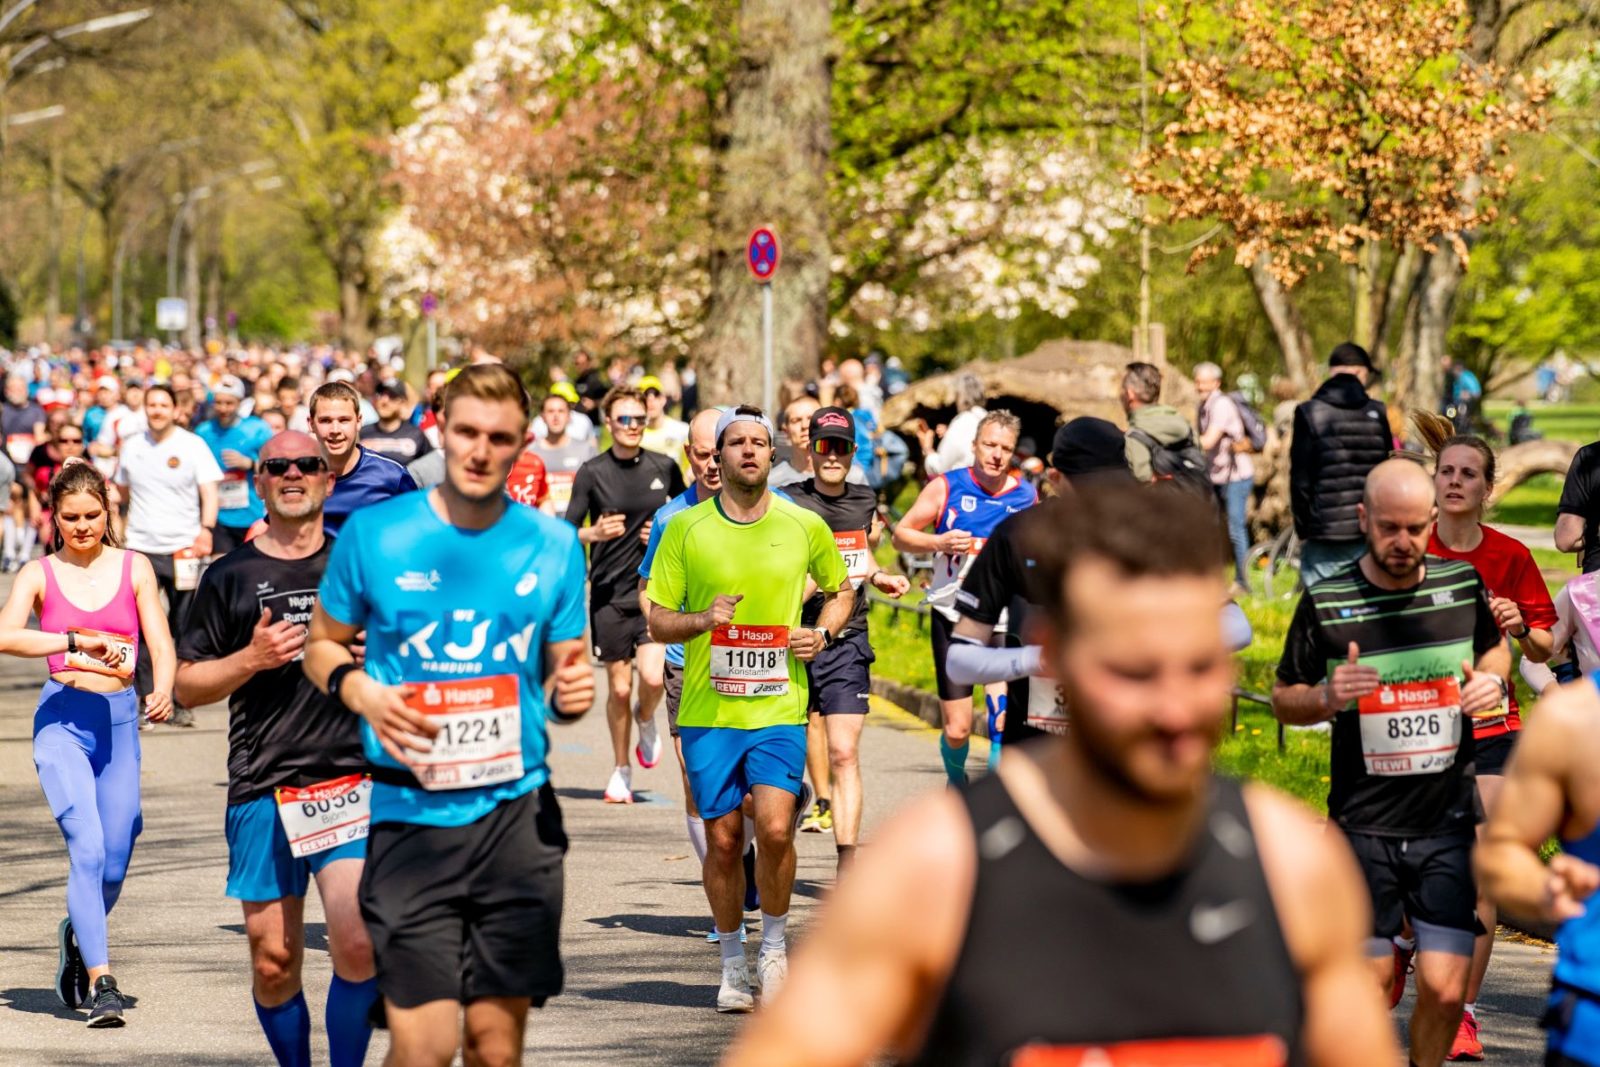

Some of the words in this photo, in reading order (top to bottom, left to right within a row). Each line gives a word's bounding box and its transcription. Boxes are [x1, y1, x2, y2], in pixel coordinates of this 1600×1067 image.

[844, 553, 858, 568] 57
[742, 630, 773, 642] Haspa
[726, 650, 776, 668] 11018
[421, 660, 483, 674] HAMBURG
[728, 667, 770, 676] Konstantin
[443, 687, 494, 703] Haspa
[716, 683, 745, 693] REWE
[763, 683, 783, 692] asics
[1398, 688, 1439, 704] Haspa
[431, 717, 501, 745] 1224
[1388, 714, 1440, 739] 8326
[1374, 759, 1410, 772] REWE
